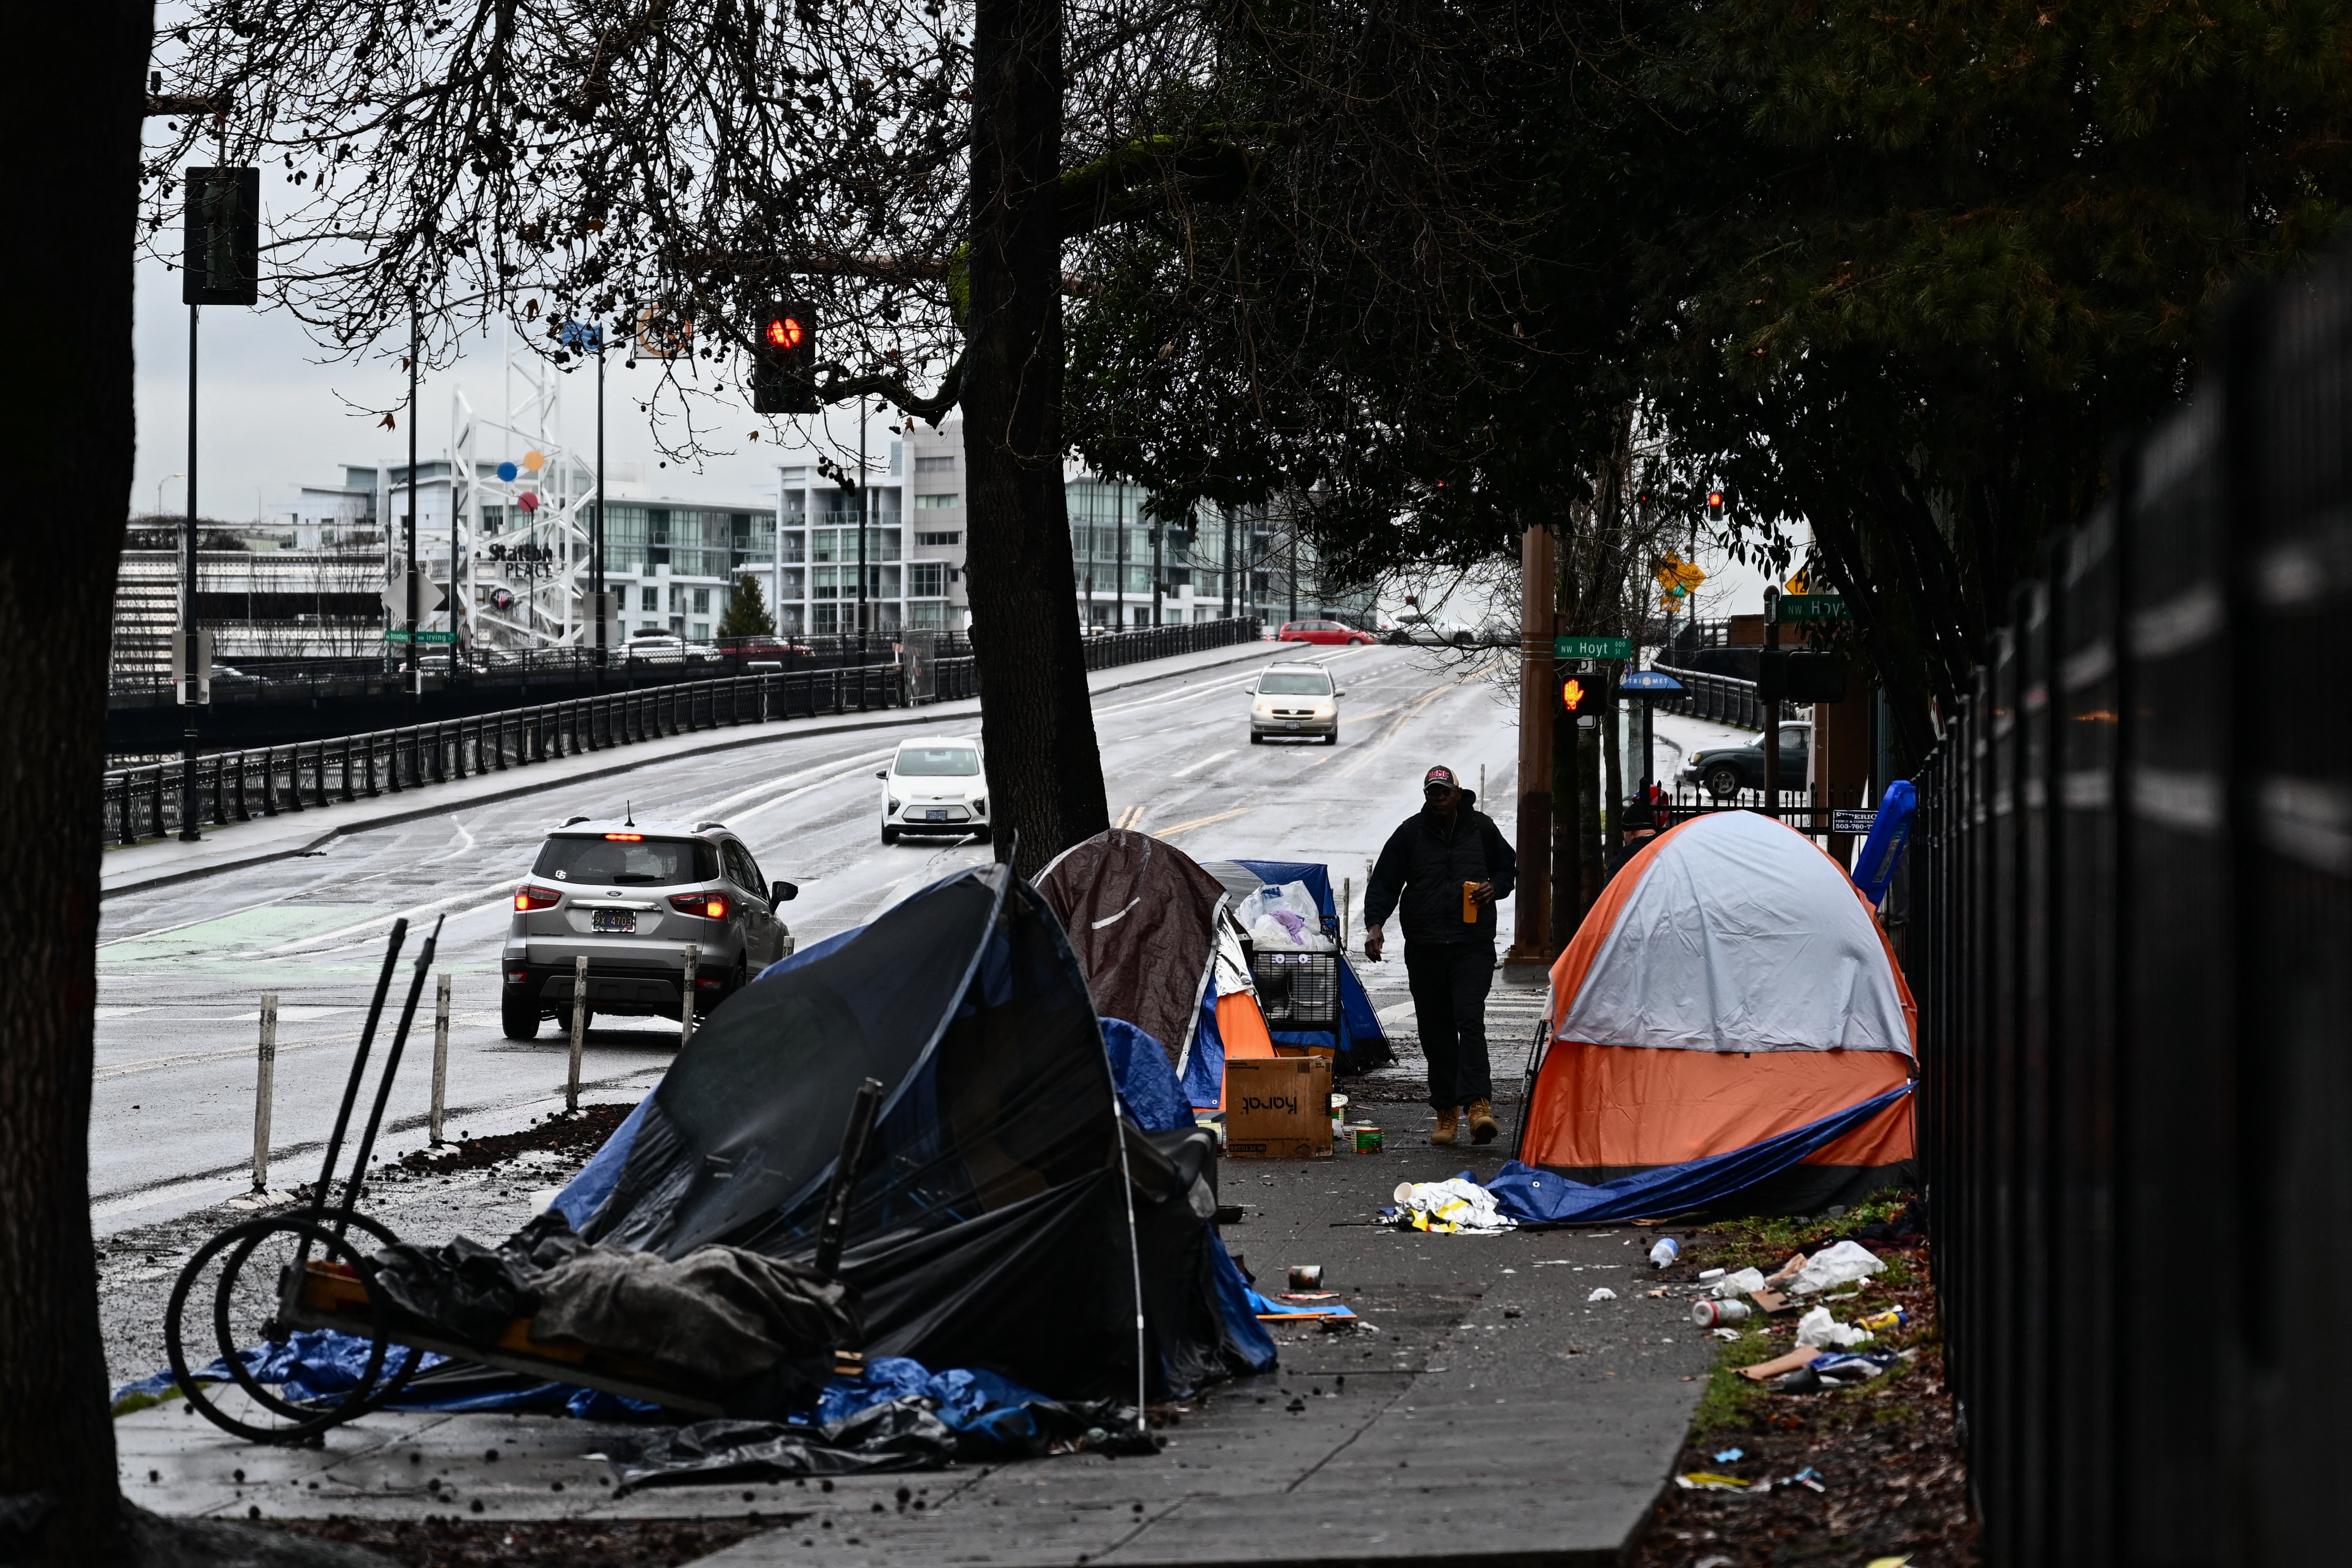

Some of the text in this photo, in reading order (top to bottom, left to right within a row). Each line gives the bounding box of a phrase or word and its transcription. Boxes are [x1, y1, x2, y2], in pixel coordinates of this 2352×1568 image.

[488, 543, 553, 562] Station
[505, 562, 553, 578] PLACE
[1788, 605, 1802, 615] NW
[390, 632, 408, 642] Broadway
[426, 634, 446, 642] Irving
[1561, 645, 1573, 653] NW
[1579, 642, 1608, 657] Hoyt
[1836, 812, 1878, 820] SERIO
[595, 916, 632, 926] 9X-4703
